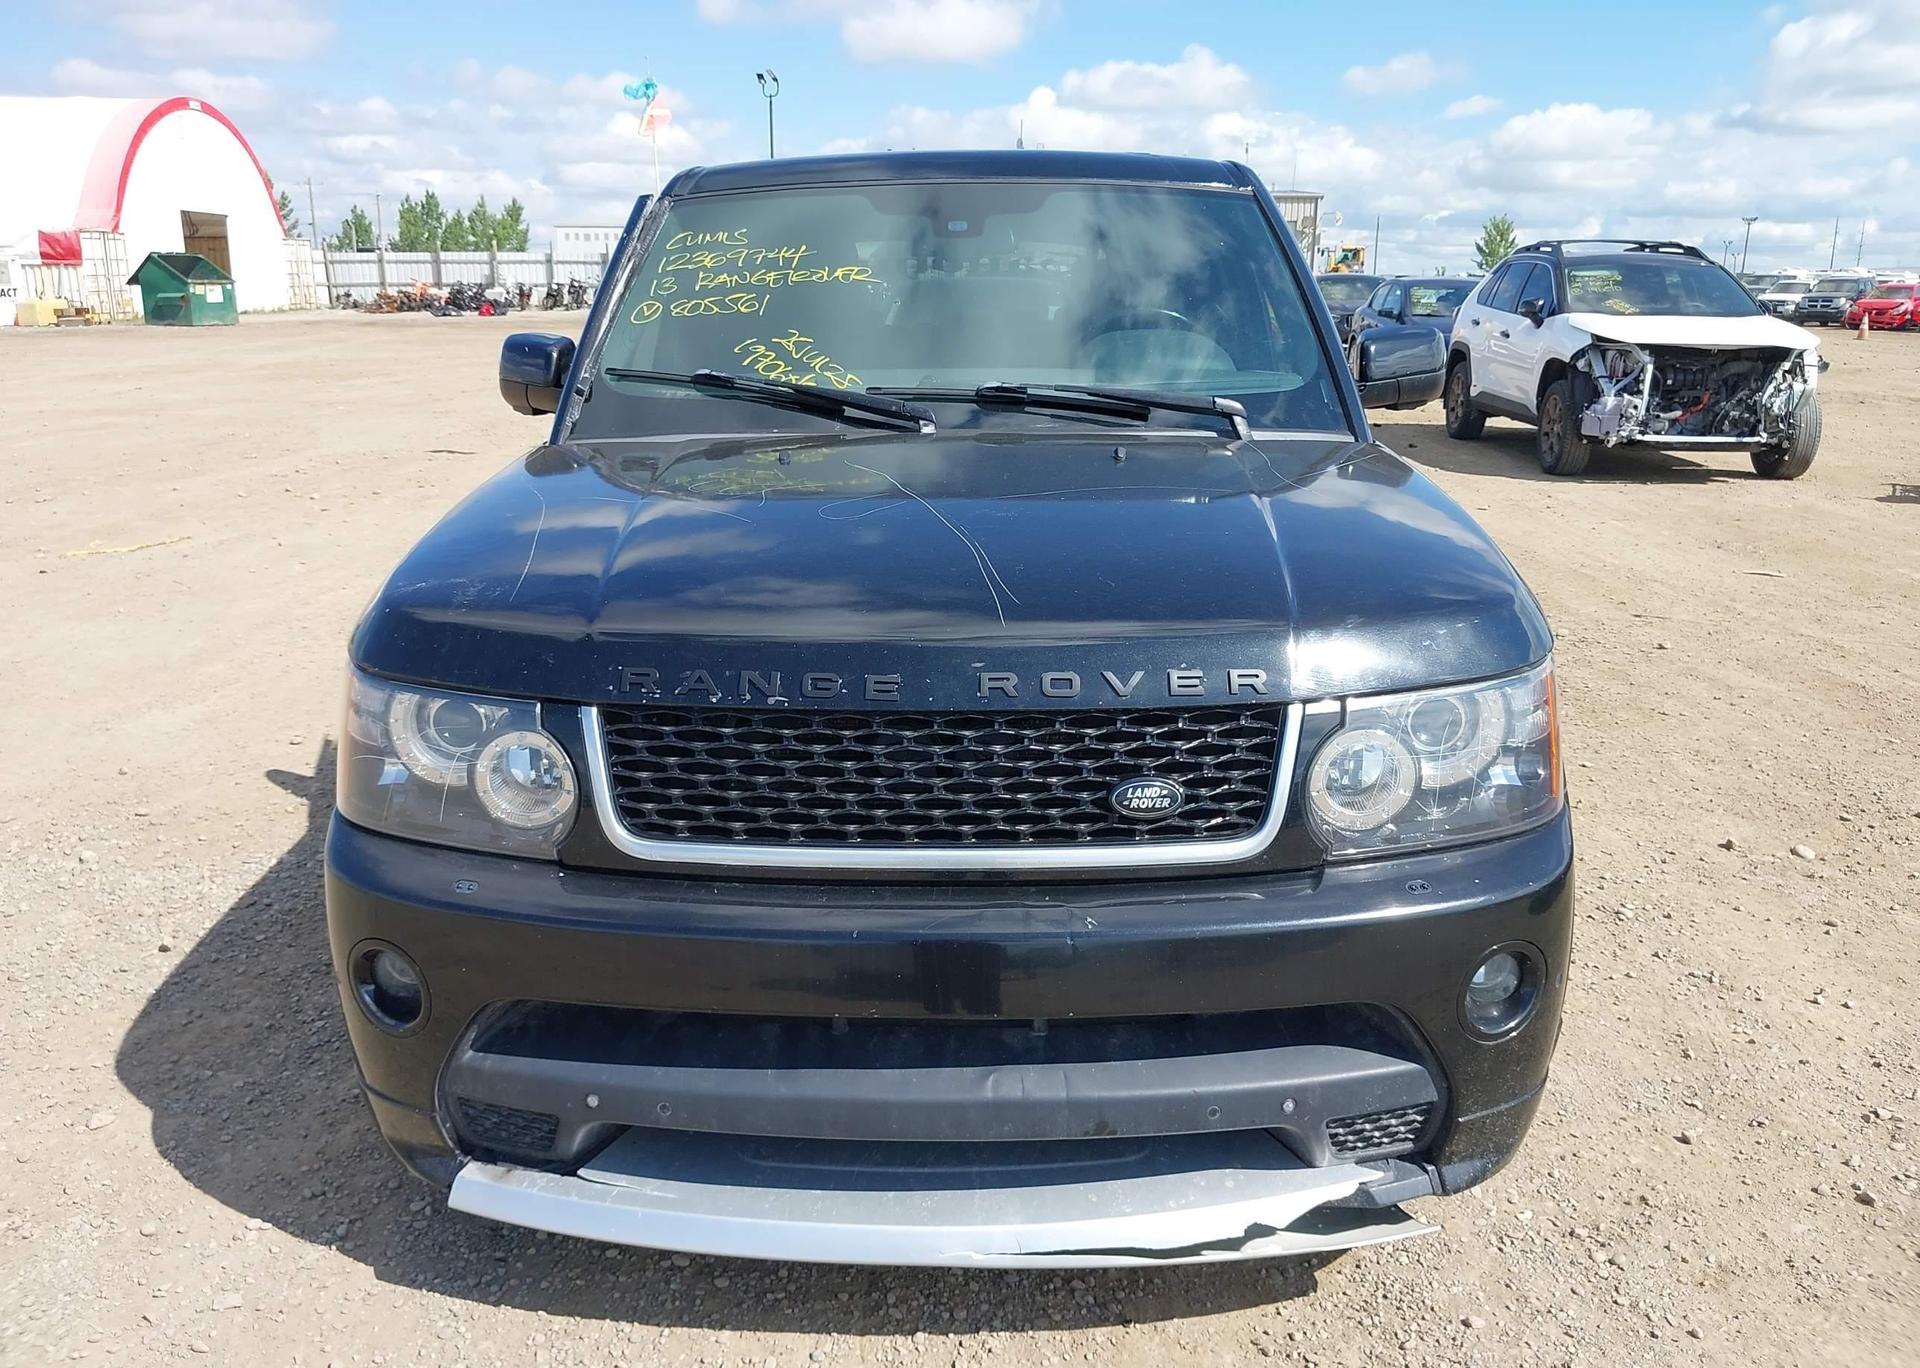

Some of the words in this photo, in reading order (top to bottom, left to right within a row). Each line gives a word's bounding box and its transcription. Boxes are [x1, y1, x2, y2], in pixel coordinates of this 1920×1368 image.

[658, 246, 817, 273] 12369744
[650, 277, 678, 297] 13
[670, 294, 770, 316] 805561
[618, 667, 900, 700] RANGE
[979, 668, 1270, 698] ROVER
[1126, 786, 1161, 798] LAND
[1129, 798, 1171, 809] ROVER
